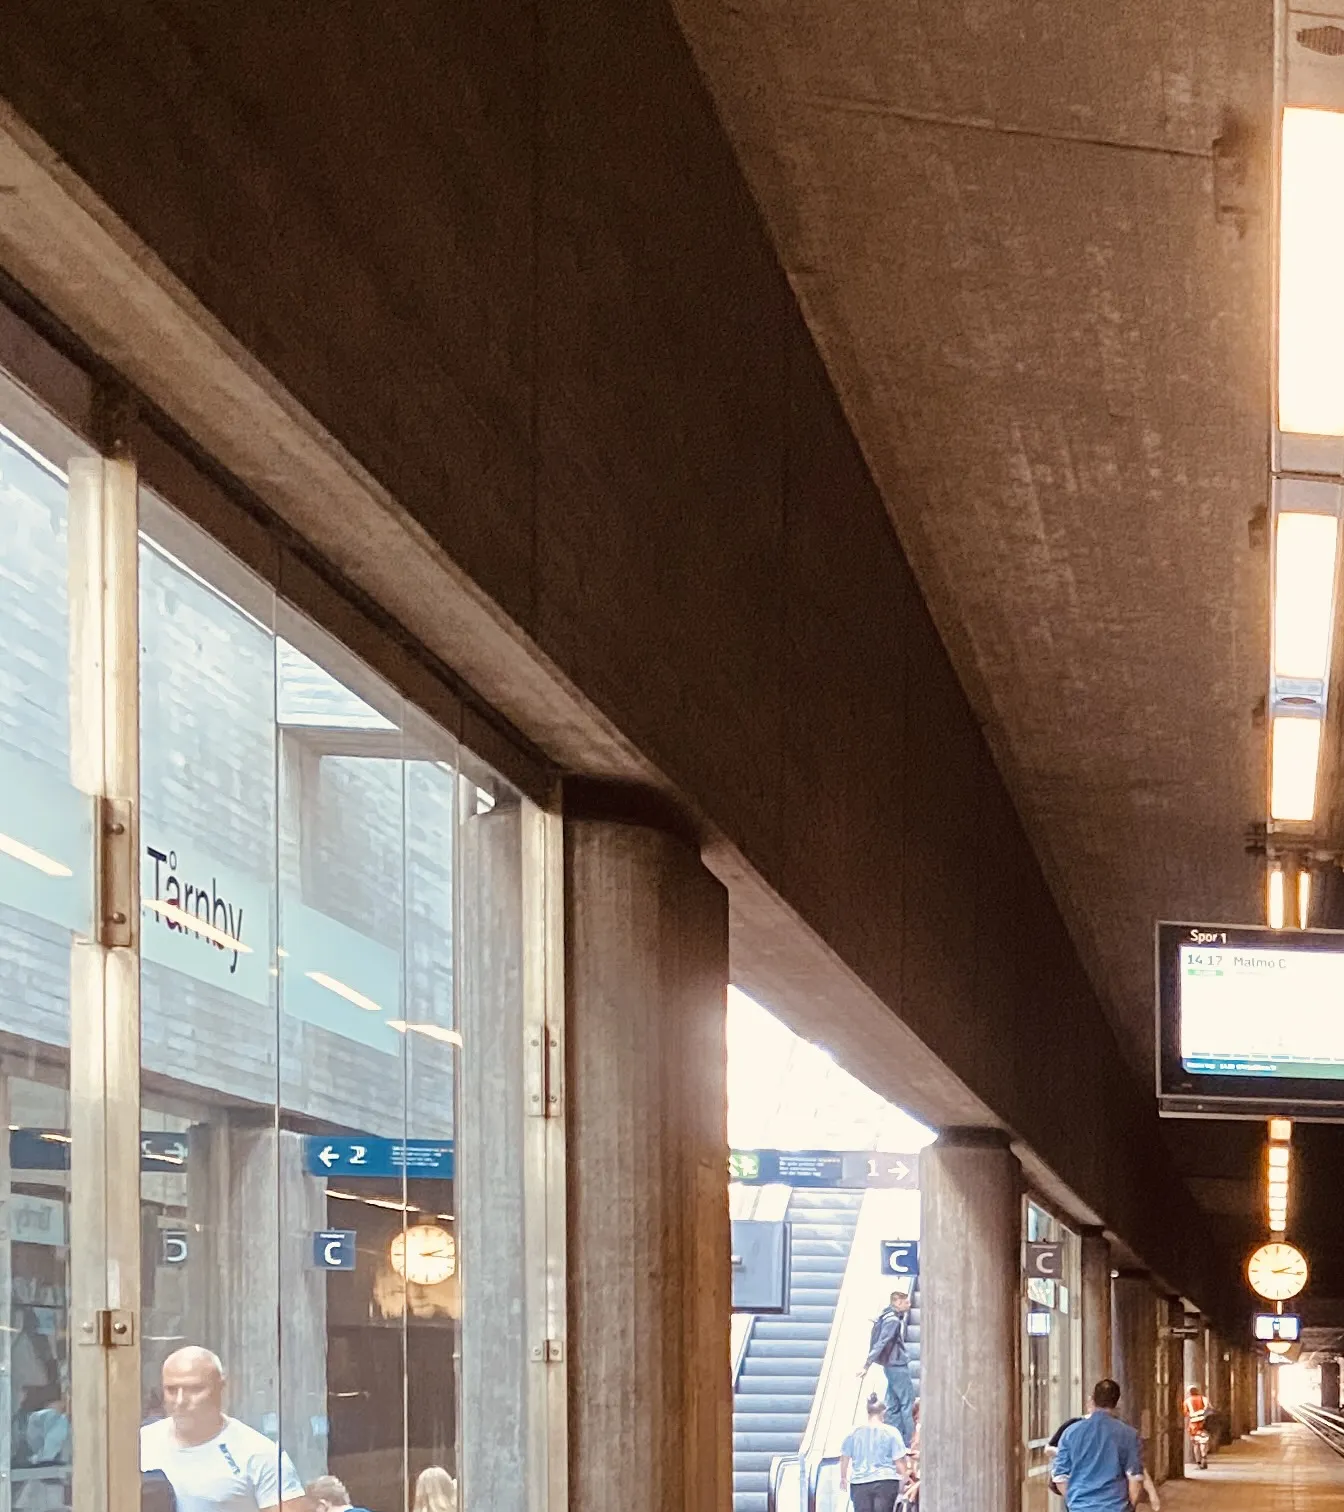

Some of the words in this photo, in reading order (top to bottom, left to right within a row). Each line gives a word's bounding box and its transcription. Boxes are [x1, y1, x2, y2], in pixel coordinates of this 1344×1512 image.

[147, 846, 243, 973] Tårnby
[1190, 929, 1217, 944] Spor
[1220, 933, 1227, 944] 1
[1278, 958, 1287, 969] C
[349, 1146, 367, 1164] 2
[867, 1159, 880, 1177] 1
[324, 1241, 342, 1265] C
[889, 1250, 909, 1273] C
[1036, 1252, 1054, 1274] C
